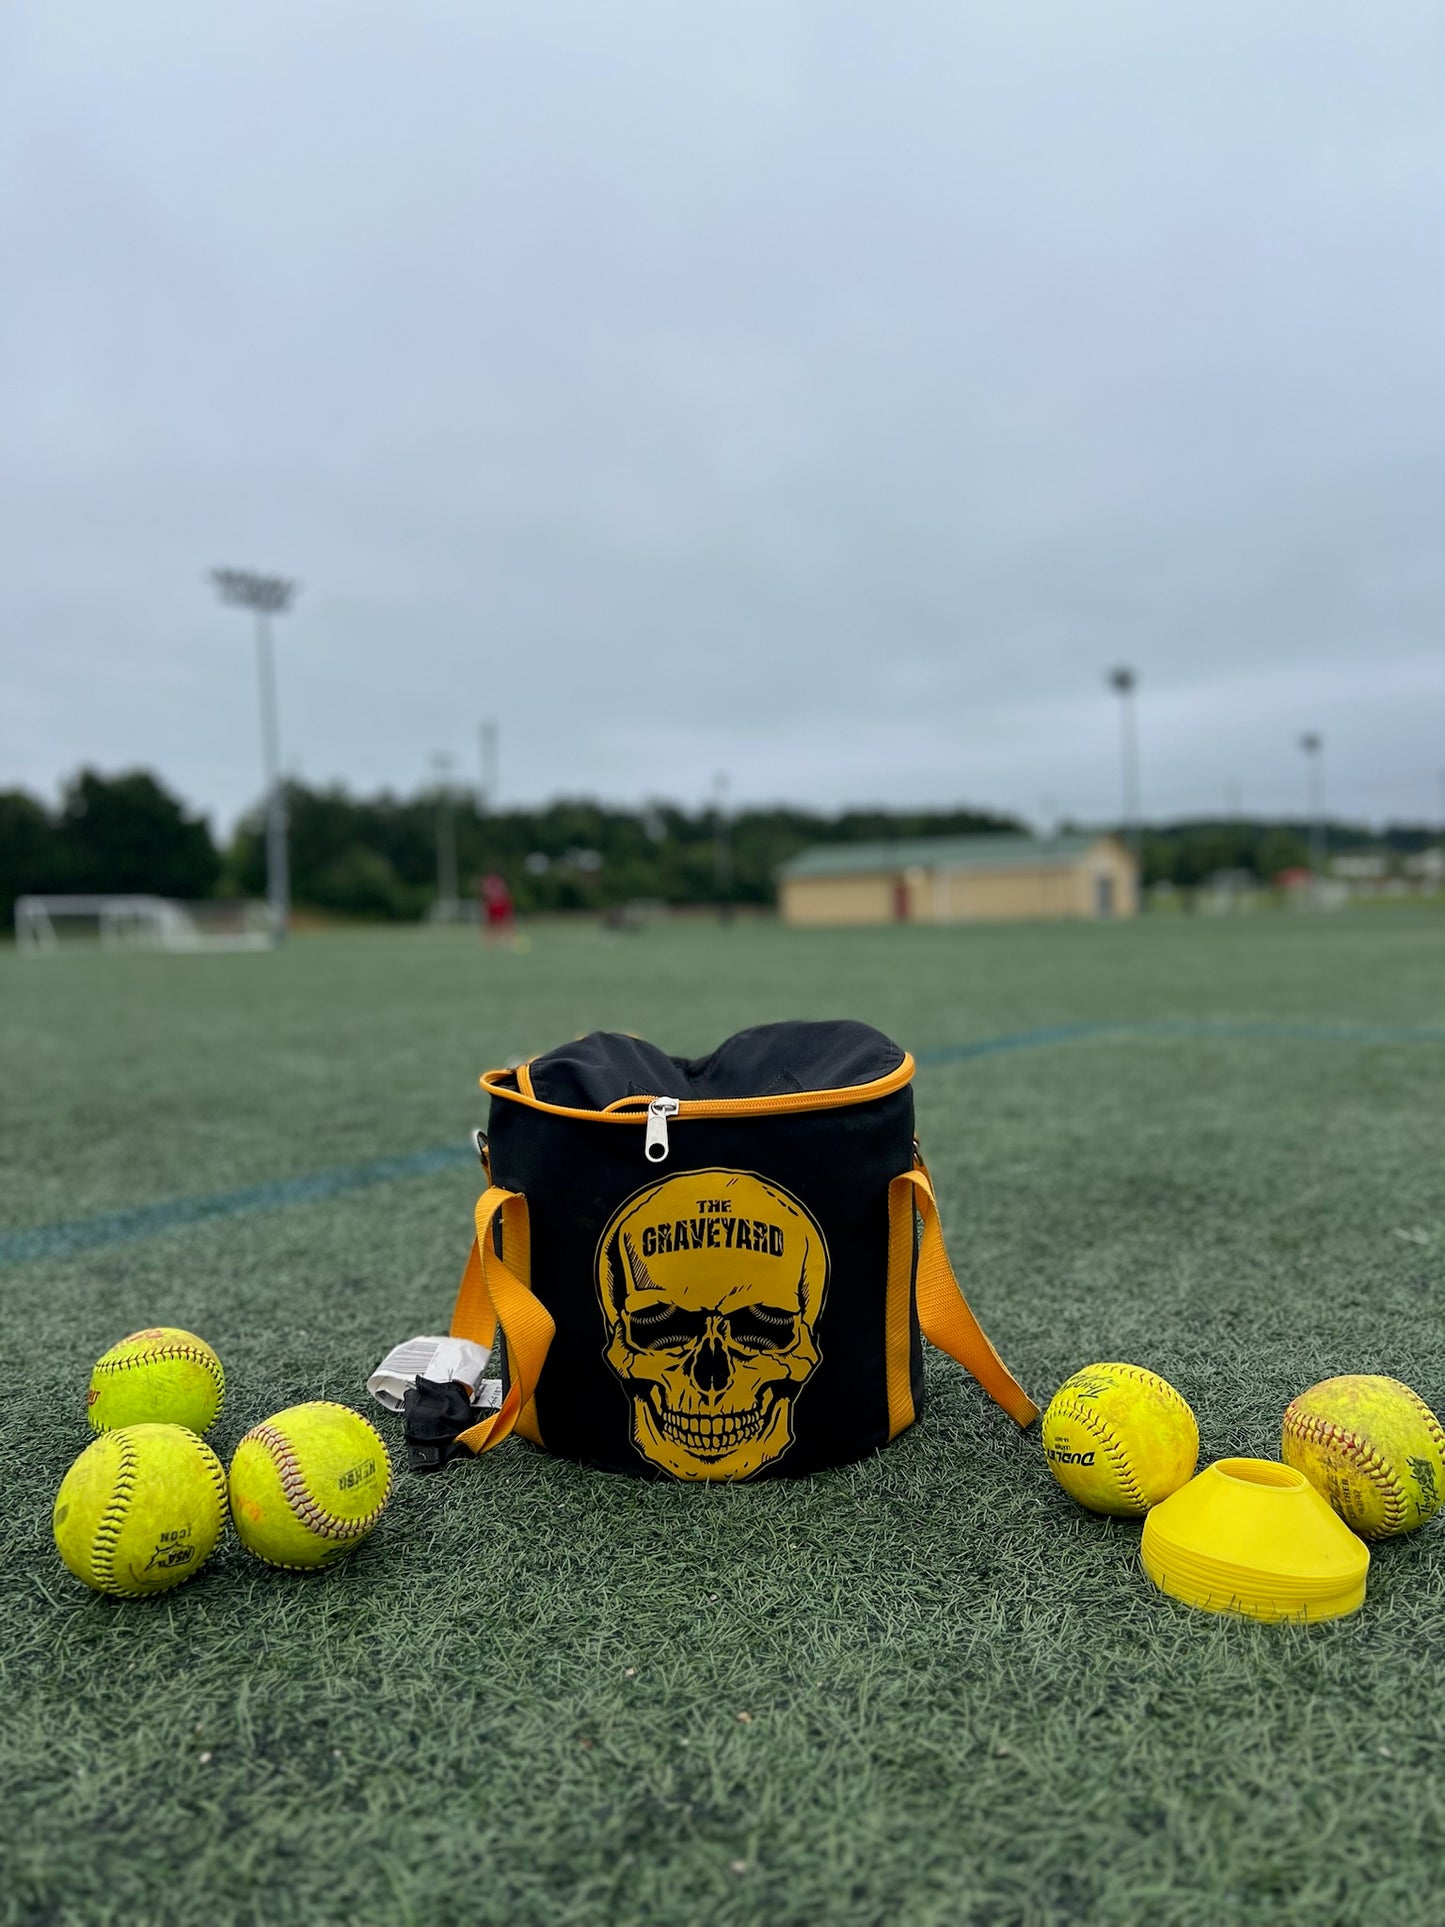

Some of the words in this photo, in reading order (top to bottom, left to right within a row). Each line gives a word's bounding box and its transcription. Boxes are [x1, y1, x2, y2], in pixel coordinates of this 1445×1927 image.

[696, 1199, 732, 1214] THE
[642, 1217, 785, 1258] GRAVEYARD
[159, 1527, 192, 1543] ICON
